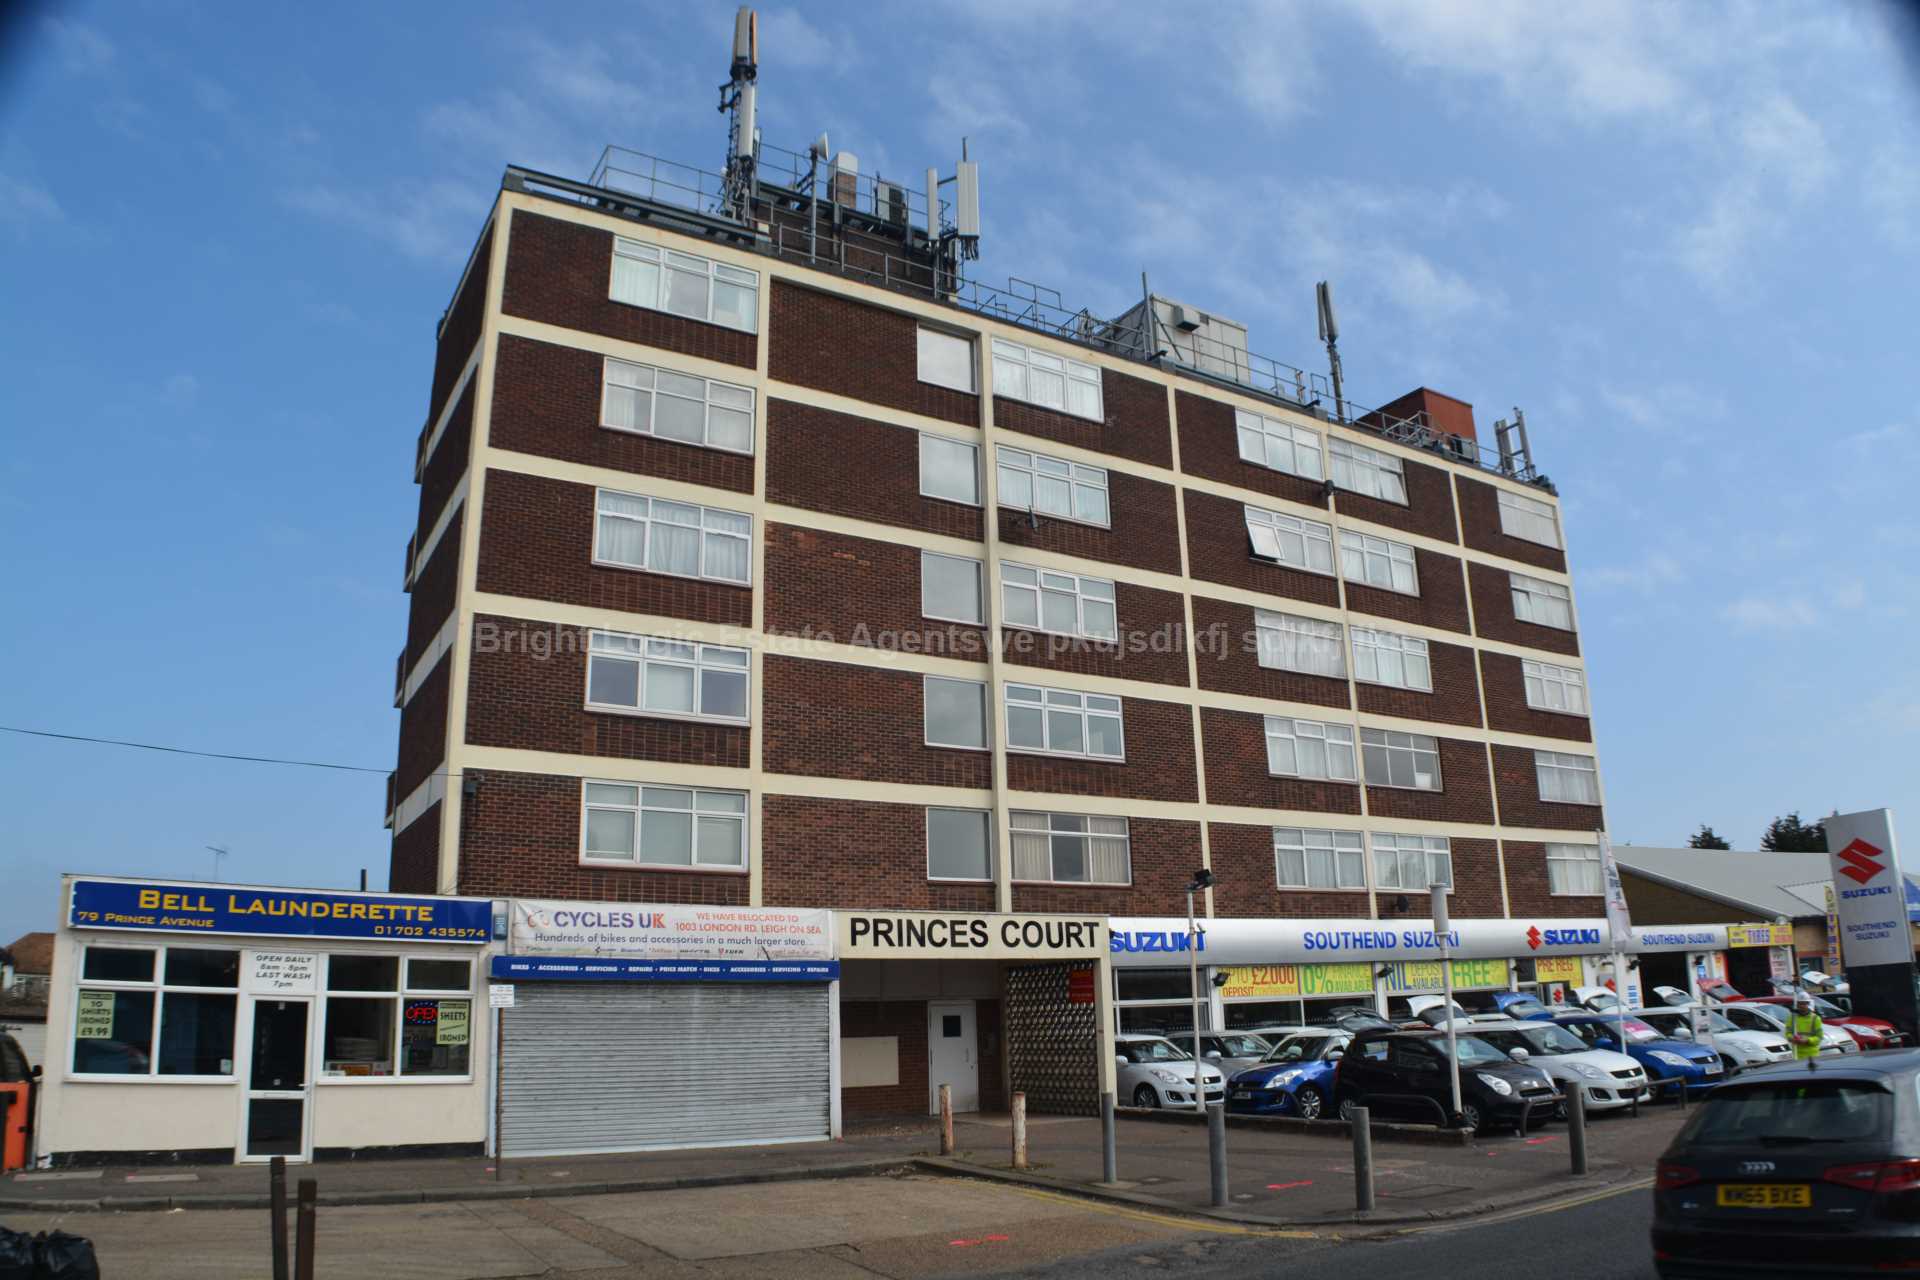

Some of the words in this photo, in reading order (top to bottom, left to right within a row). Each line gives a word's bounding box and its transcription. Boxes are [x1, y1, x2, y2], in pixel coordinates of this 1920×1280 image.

[1841, 885, 1892, 899] SUZUKI
[138, 889, 215, 912] BELL
[228, 895, 434, 922] LAUNDERETTE
[77, 911, 99, 921] 79
[104, 913, 156, 925] PRINCE
[160, 916, 215, 928] AVENUE
[554, 911, 634, 928] CYCLES
[639, 913, 667, 929] UK
[696, 912, 710, 920] WE
[715, 912, 735, 921] HAVE
[738, 913, 785, 922] RELOCATED
[374, 925, 424, 936] 01702
[428, 928, 486, 938] 435574
[675, 922, 697, 932] 1003
[700, 924, 742, 933] LONDON
[761, 925, 787, 934] LEIGH
[790, 926, 804, 934] ON
[806, 926, 822, 934] SEA
[850, 917, 989, 949] PRINCES
[1000, 920, 1100, 949] COURT
[1847, 921, 1898, 932] SOUTHEND
[535, 933, 585, 943] Hundreds
[587, 933, 598, 943] of
[601, 934, 626, 943] bikes
[629, 934, 648, 944] and
[650, 936, 705, 945] accessories
[707, 936, 716, 945] in
[727, 936, 751, 946] much
[754, 937, 781, 947] larger
[1303, 931, 1397, 950] SOUTHEND
[1544, 928, 1600, 945] SUZUKI
[1642, 934, 1686, 946] SOUTHEND
[1688, 932, 1716, 944] SUZUKI
[1855, 930, 1890, 941] SUZUKI
[255, 954, 282, 962] OPEN
[1452, 960, 1490, 990] FREE
[1222, 986, 1254, 998] DEPOSIT
